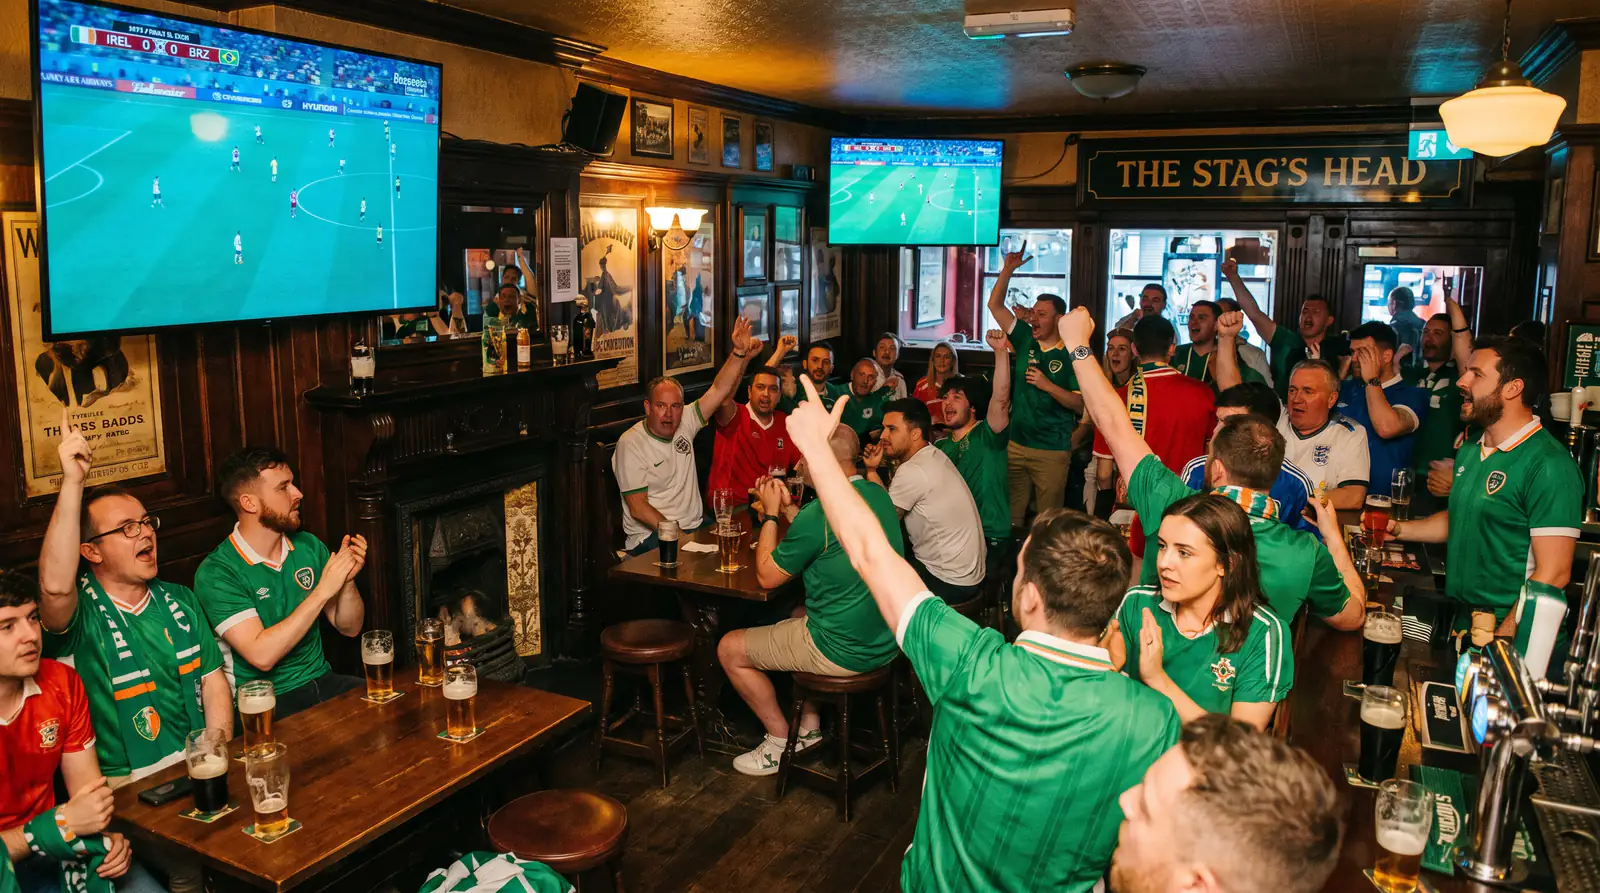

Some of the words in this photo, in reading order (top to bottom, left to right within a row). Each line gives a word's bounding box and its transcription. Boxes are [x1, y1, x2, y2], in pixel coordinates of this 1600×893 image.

[106, 34, 132, 48] IREL
[142, 39, 151, 51] 0
[170, 44, 178, 55] 0
[189, 47, 210, 60] BRZ
[1116, 159, 1181, 188] THE
[1192, 156, 1308, 188] STAG'S
[1323, 156, 1427, 187] HEAD
